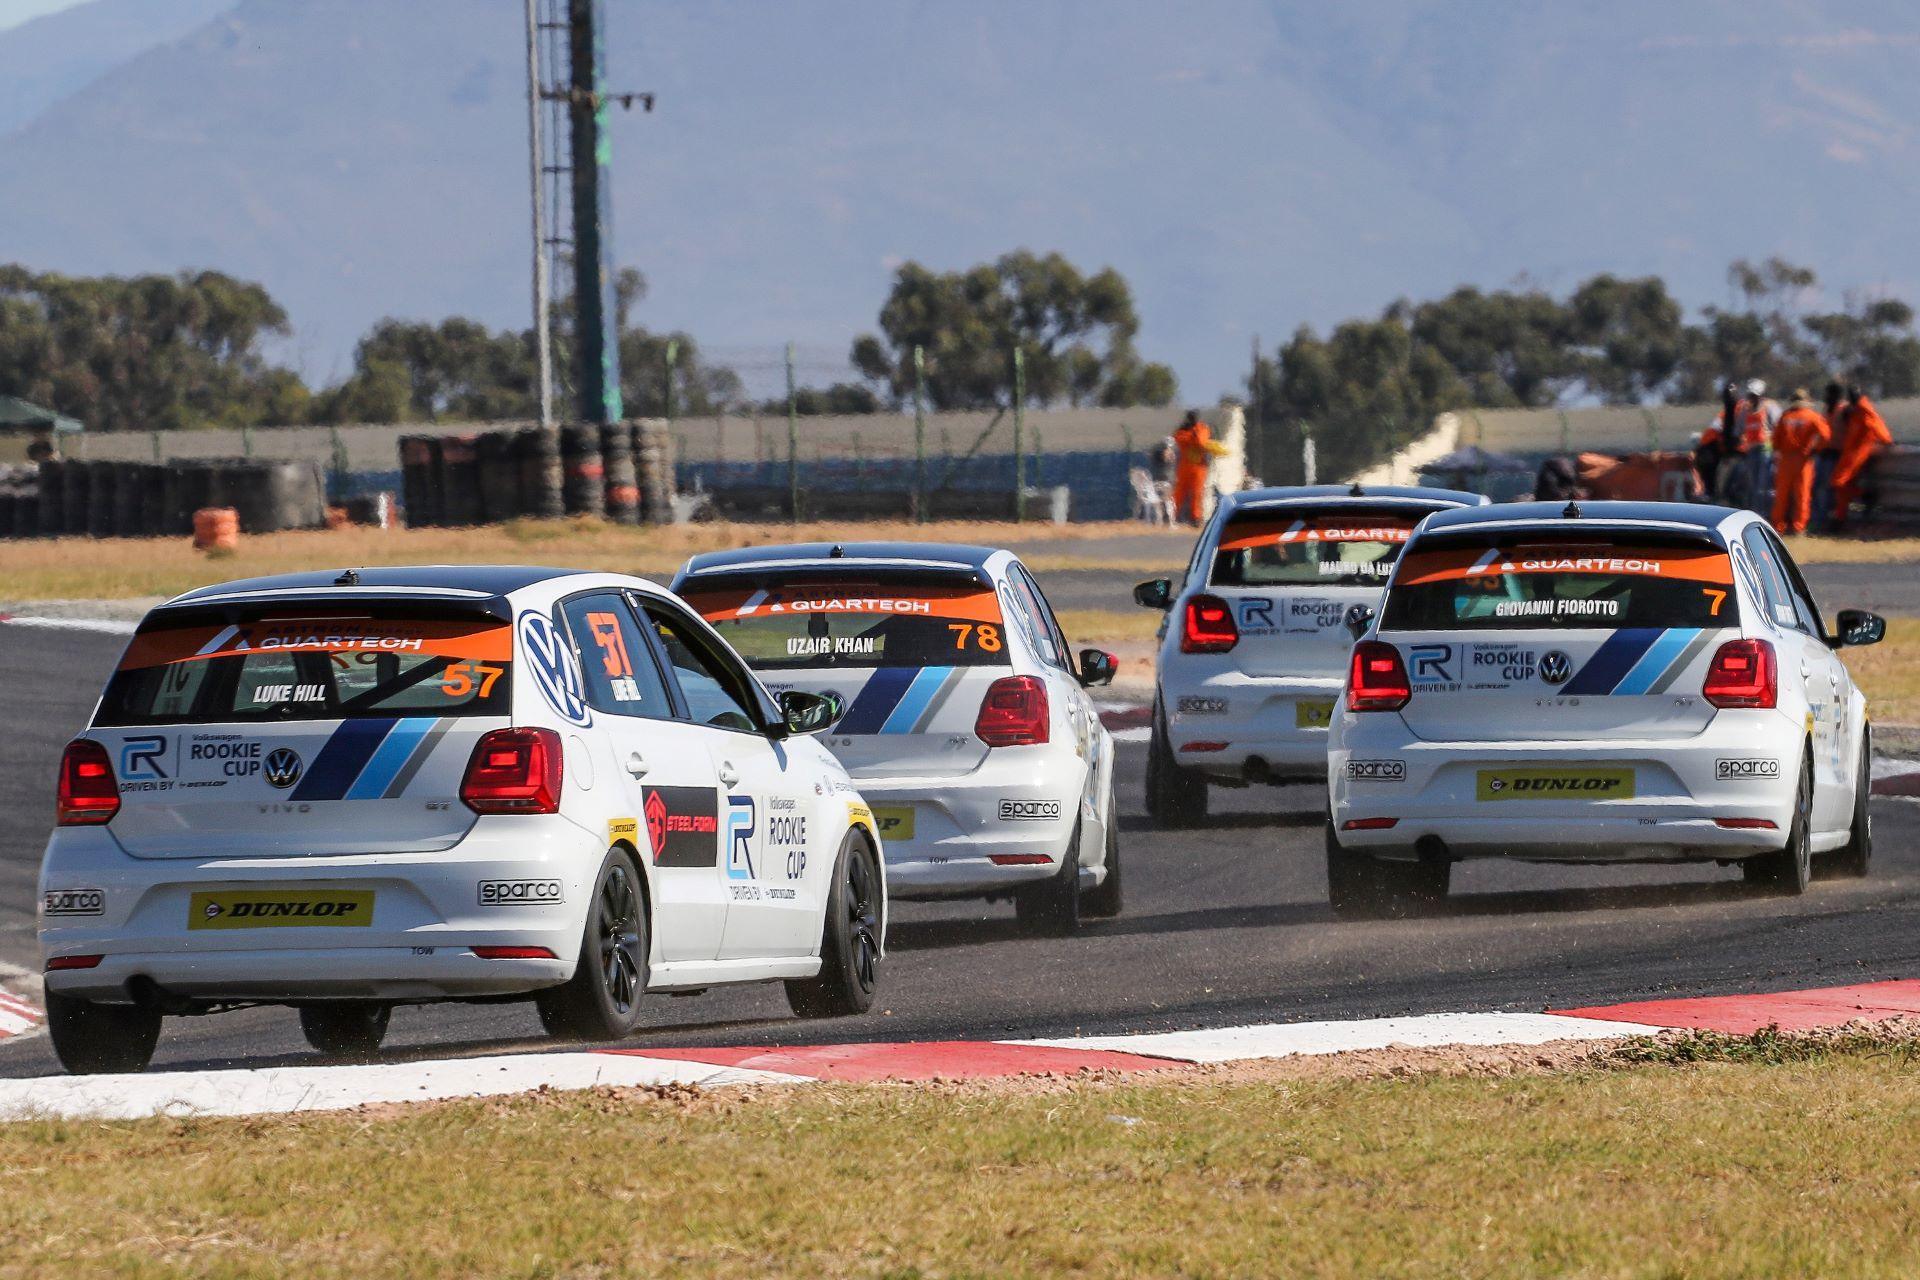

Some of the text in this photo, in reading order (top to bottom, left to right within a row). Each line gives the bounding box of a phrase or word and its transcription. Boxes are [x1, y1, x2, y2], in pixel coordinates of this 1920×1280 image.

[1325, 529, 1410, 539] QUARTE
[1521, 558, 1660, 573] QUARTECH
[790, 598, 930, 613] QUARTECH
[1291, 602, 1344, 616] ROOKIE
[1496, 599, 1619, 617] GIOVANNI FIOROTTO
[1702, 588, 1727, 616] 7
[260, 636, 423, 650] QUARTECH
[786, 637, 875, 655] UZAIR KHAN
[948, 624, 1002, 653] 78
[1472, 651, 1536, 666] ROOKIE
[1502, 665, 1535, 680] CUP
[440, 664, 503, 699] 57
[1412, 682, 1462, 693] DRIVEN BY
[253, 684, 326, 703] LUKE HILL
[191, 733, 243, 742] Volkswagen
[190, 742, 261, 760] ROOKIE
[223, 760, 262, 777] CUP
[1347, 761, 1403, 778] sparco
[1718, 760, 1777, 777] sparco
[120, 780, 174, 793] DRIVEN BY
[1512, 778, 1620, 791] DUNLOP
[1001, 801, 1059, 819] sparco
[1638, 818, 1657, 826] TOW
[769, 816, 806, 846] ROOKIE
[786, 850, 807, 880] CUP
[482, 881, 561, 903] sparco
[226, 901, 359, 919] DUNLOP
[411, 946, 435, 956] TOW
